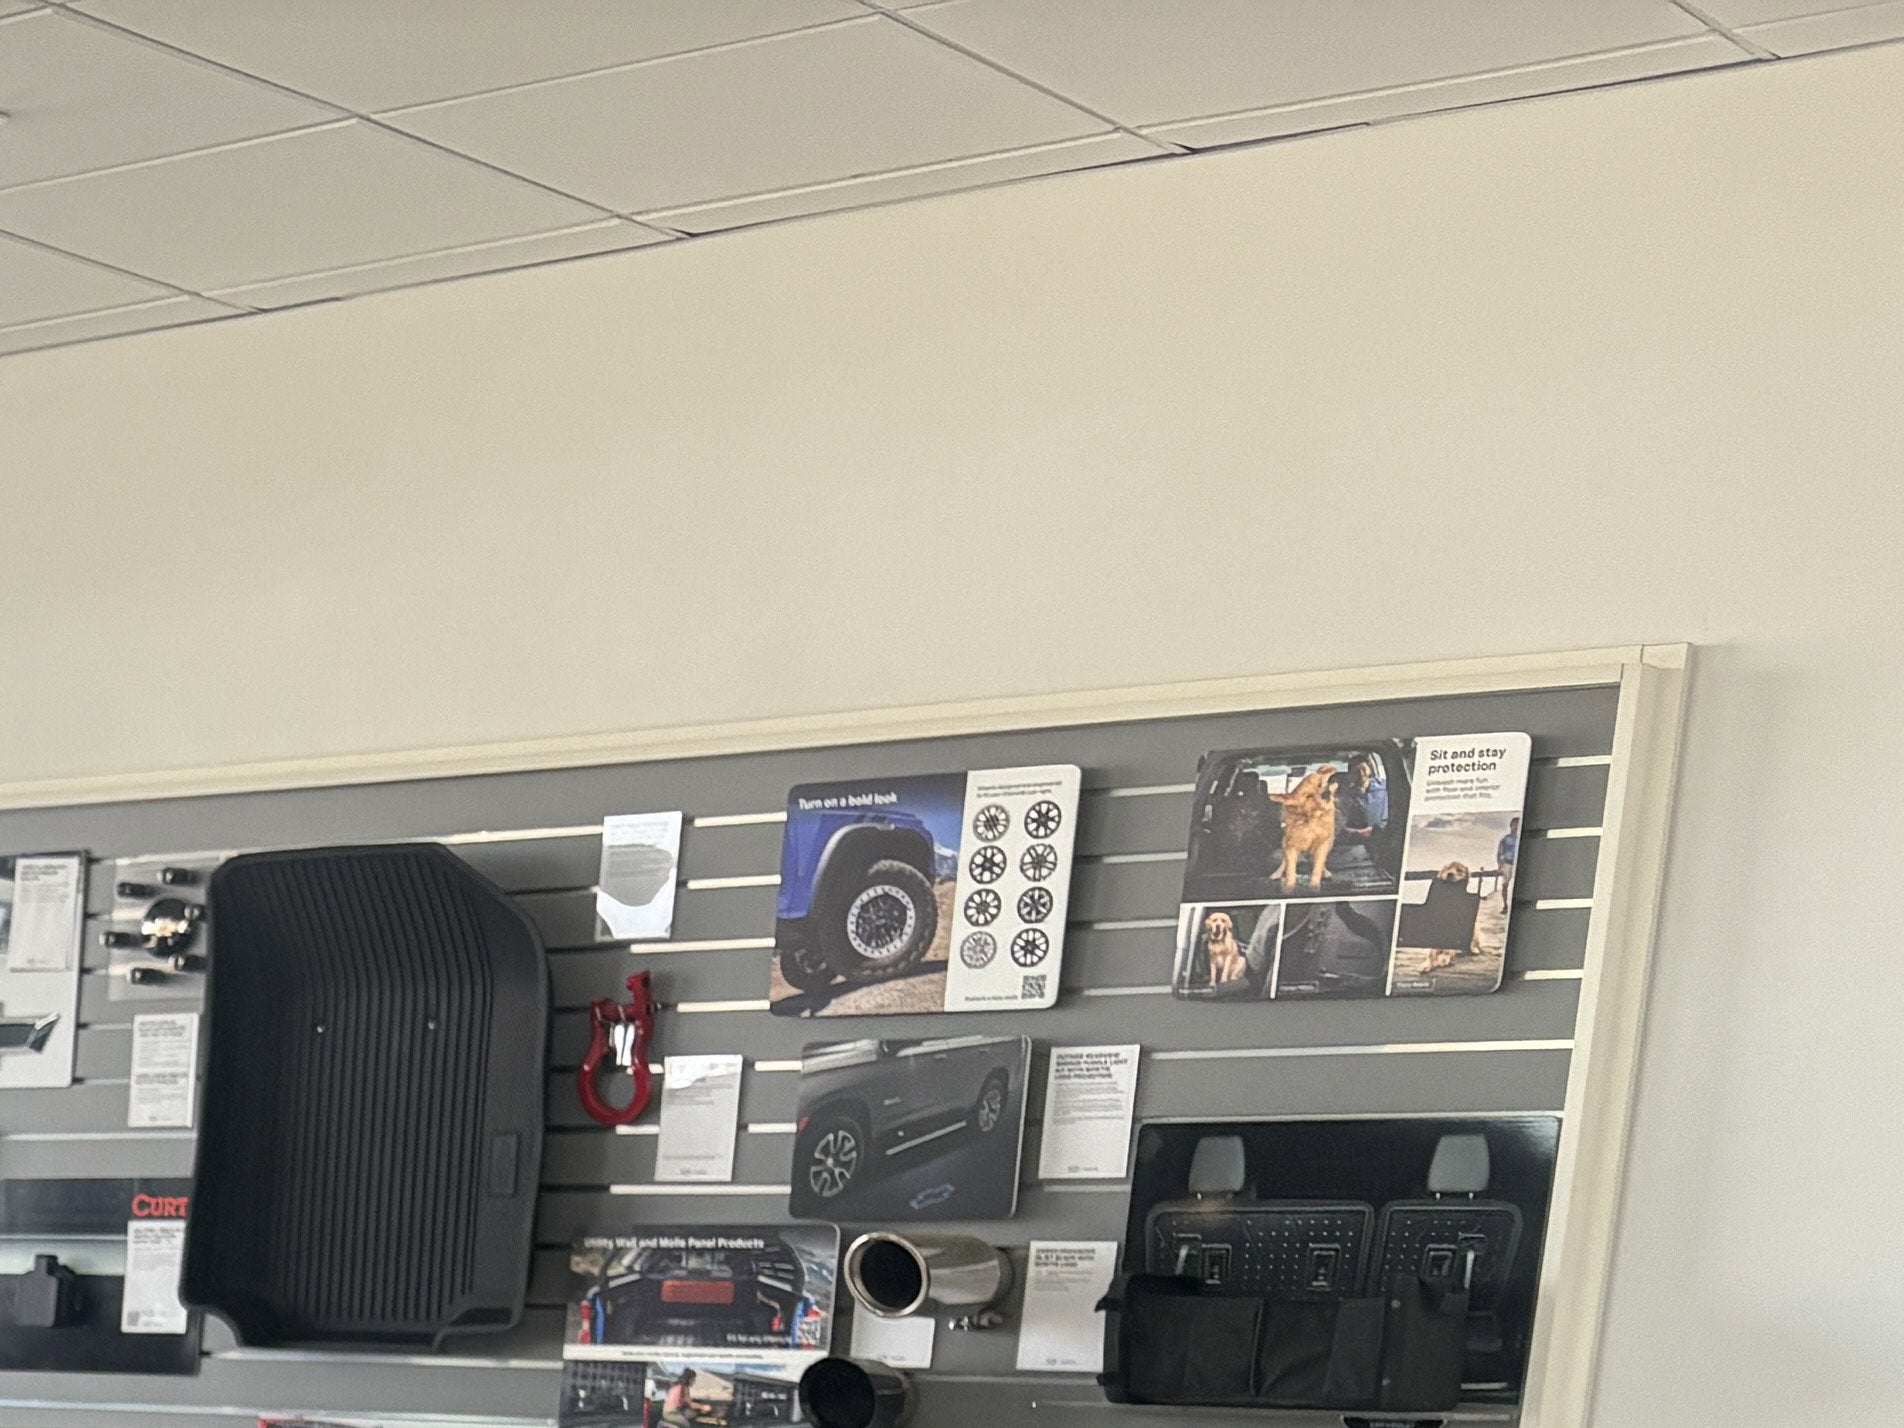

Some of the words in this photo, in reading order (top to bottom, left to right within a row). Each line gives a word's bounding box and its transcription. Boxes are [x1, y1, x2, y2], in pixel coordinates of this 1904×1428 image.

[1430, 749, 1448, 760] Sit
[1451, 748, 1475, 759] and
[1478, 748, 1506, 759] stay
[1428, 761, 1496, 776] protection
[798, 798, 822, 810] Turn
[824, 798, 838, 808] on
[839, 797, 846, 807] a
[848, 793, 873, 806] bold
[874, 791, 897, 804] look
[132, 1194, 190, 1218] CURT
[639, 1237, 657, 1248] and
[688, 1236, 716, 1248] Panel
[718, 1237, 765, 1249] Products
